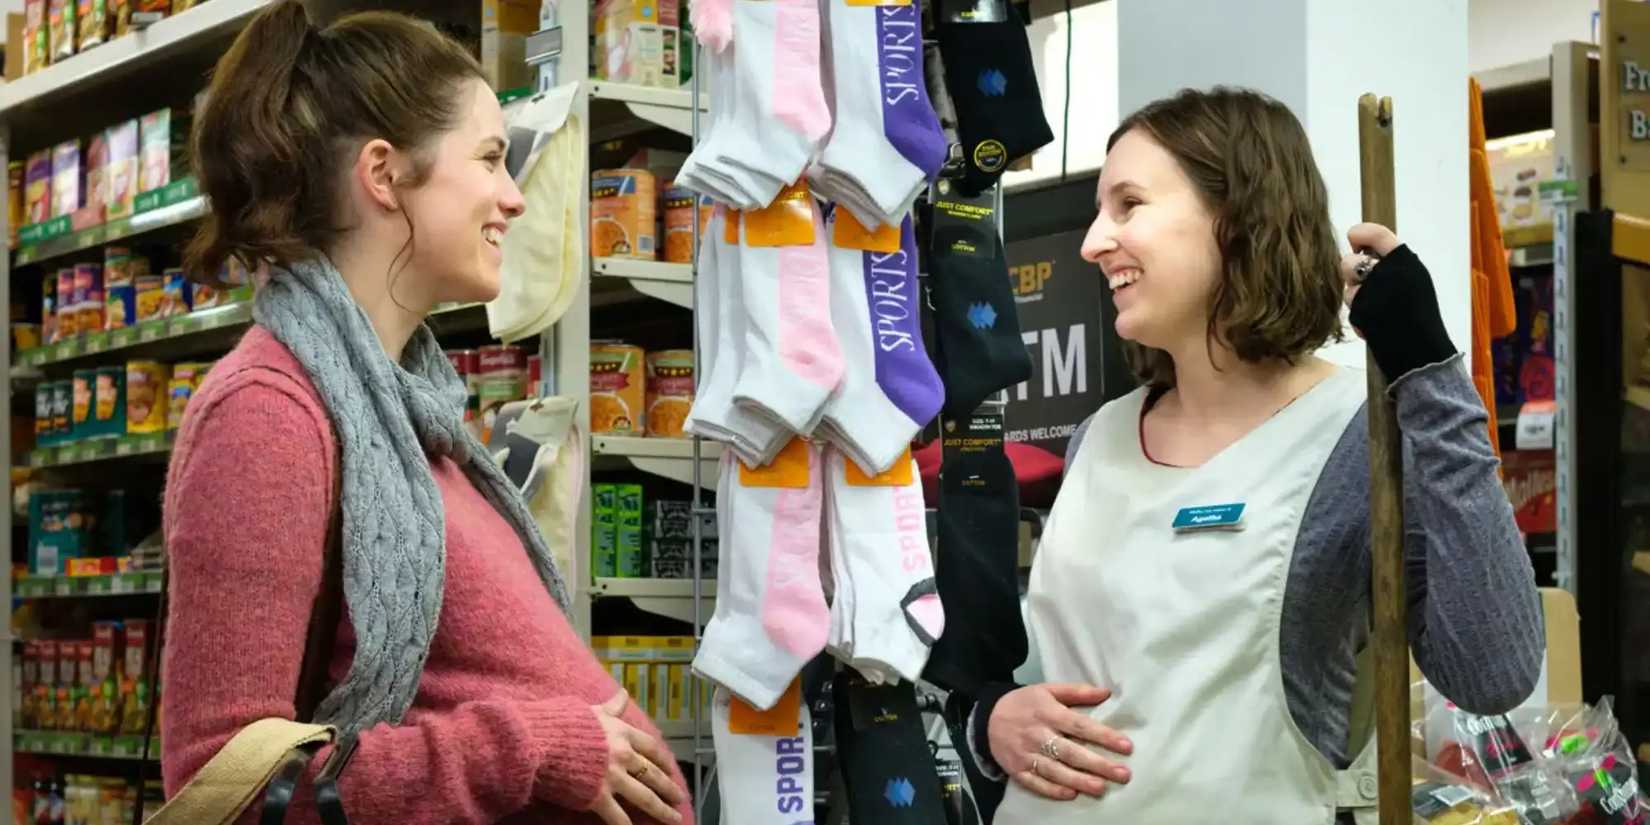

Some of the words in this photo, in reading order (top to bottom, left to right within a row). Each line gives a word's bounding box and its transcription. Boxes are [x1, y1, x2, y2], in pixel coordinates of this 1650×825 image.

[1631, 110, 1650, 138] B
[1003, 429, 1029, 443] ARDS
[1029, 423, 1077, 441] WELCOME
[893, 486, 927, 571] SPOR
[776, 734, 804, 813] SPOR
